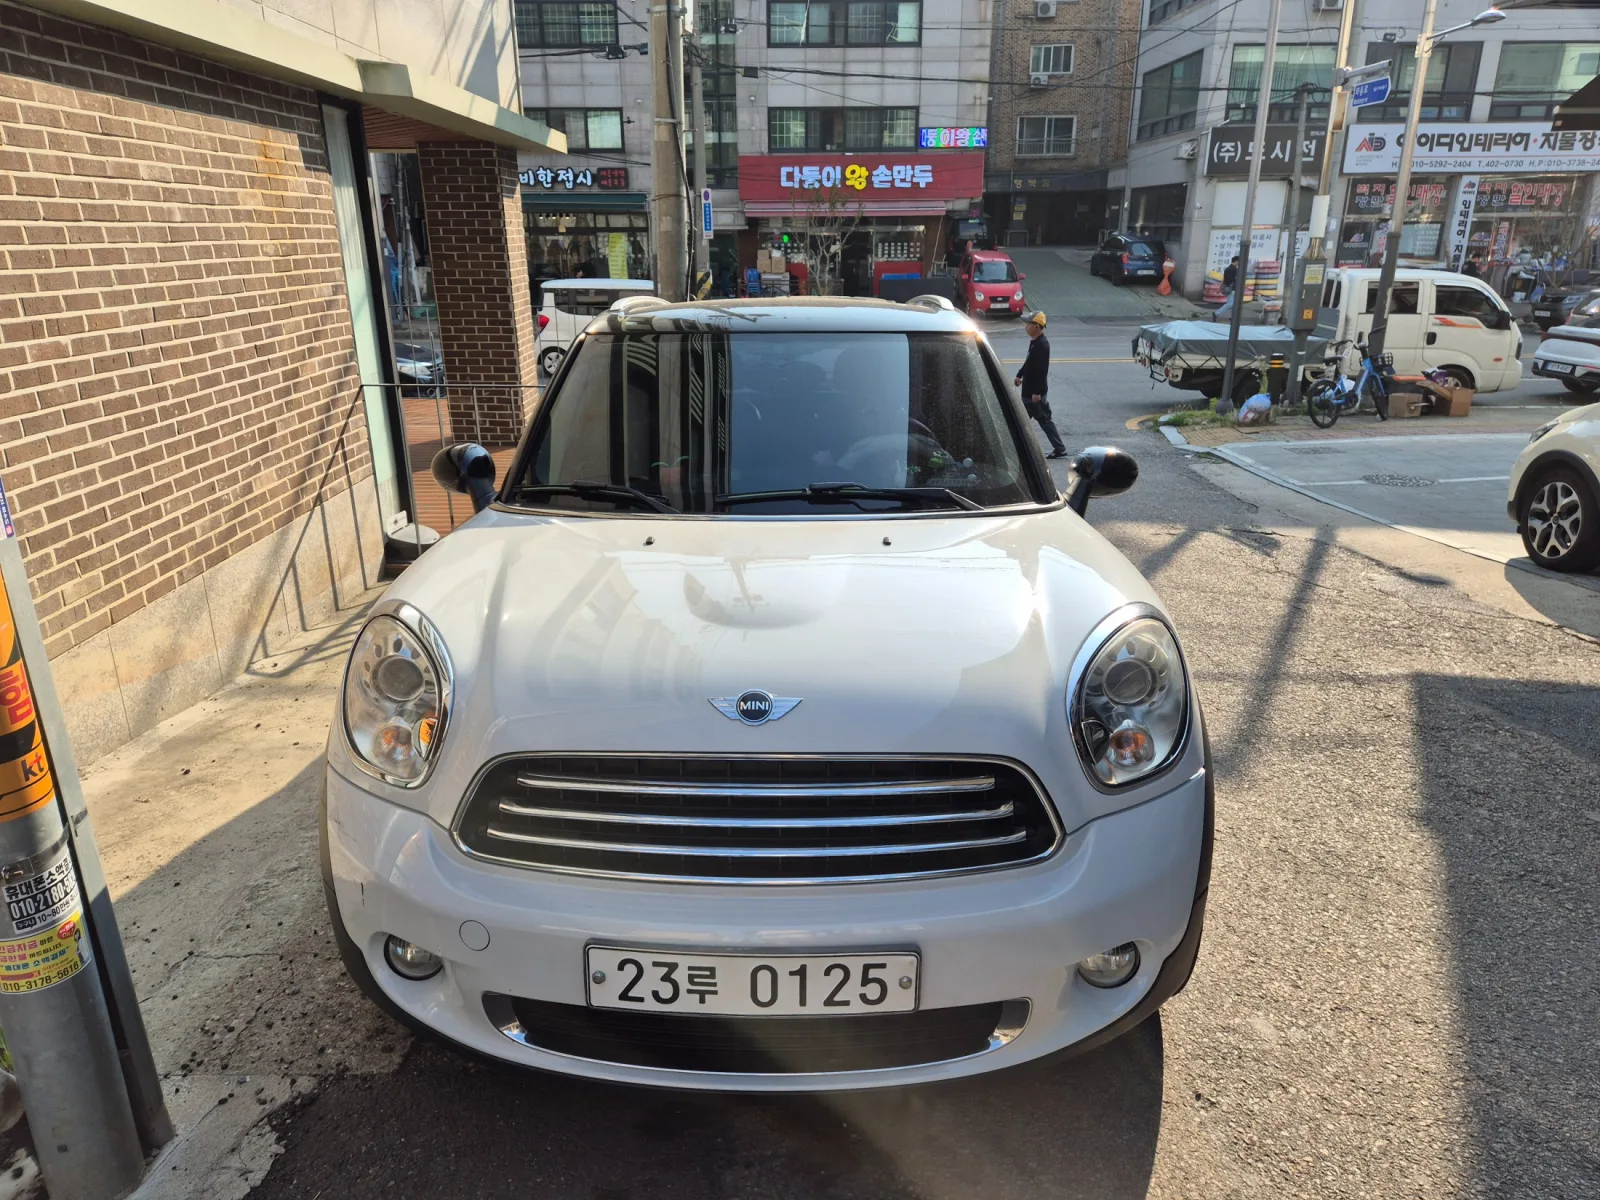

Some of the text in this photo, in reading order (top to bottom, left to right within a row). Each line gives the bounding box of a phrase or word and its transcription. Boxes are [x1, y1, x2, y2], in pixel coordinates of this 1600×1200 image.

[780, 164, 933, 190] 다둥이 왕 손만두
[740, 701, 769, 710] MINI
[21, 753, 44, 782] kt
[617, 958, 889, 1008] 23루 0125
